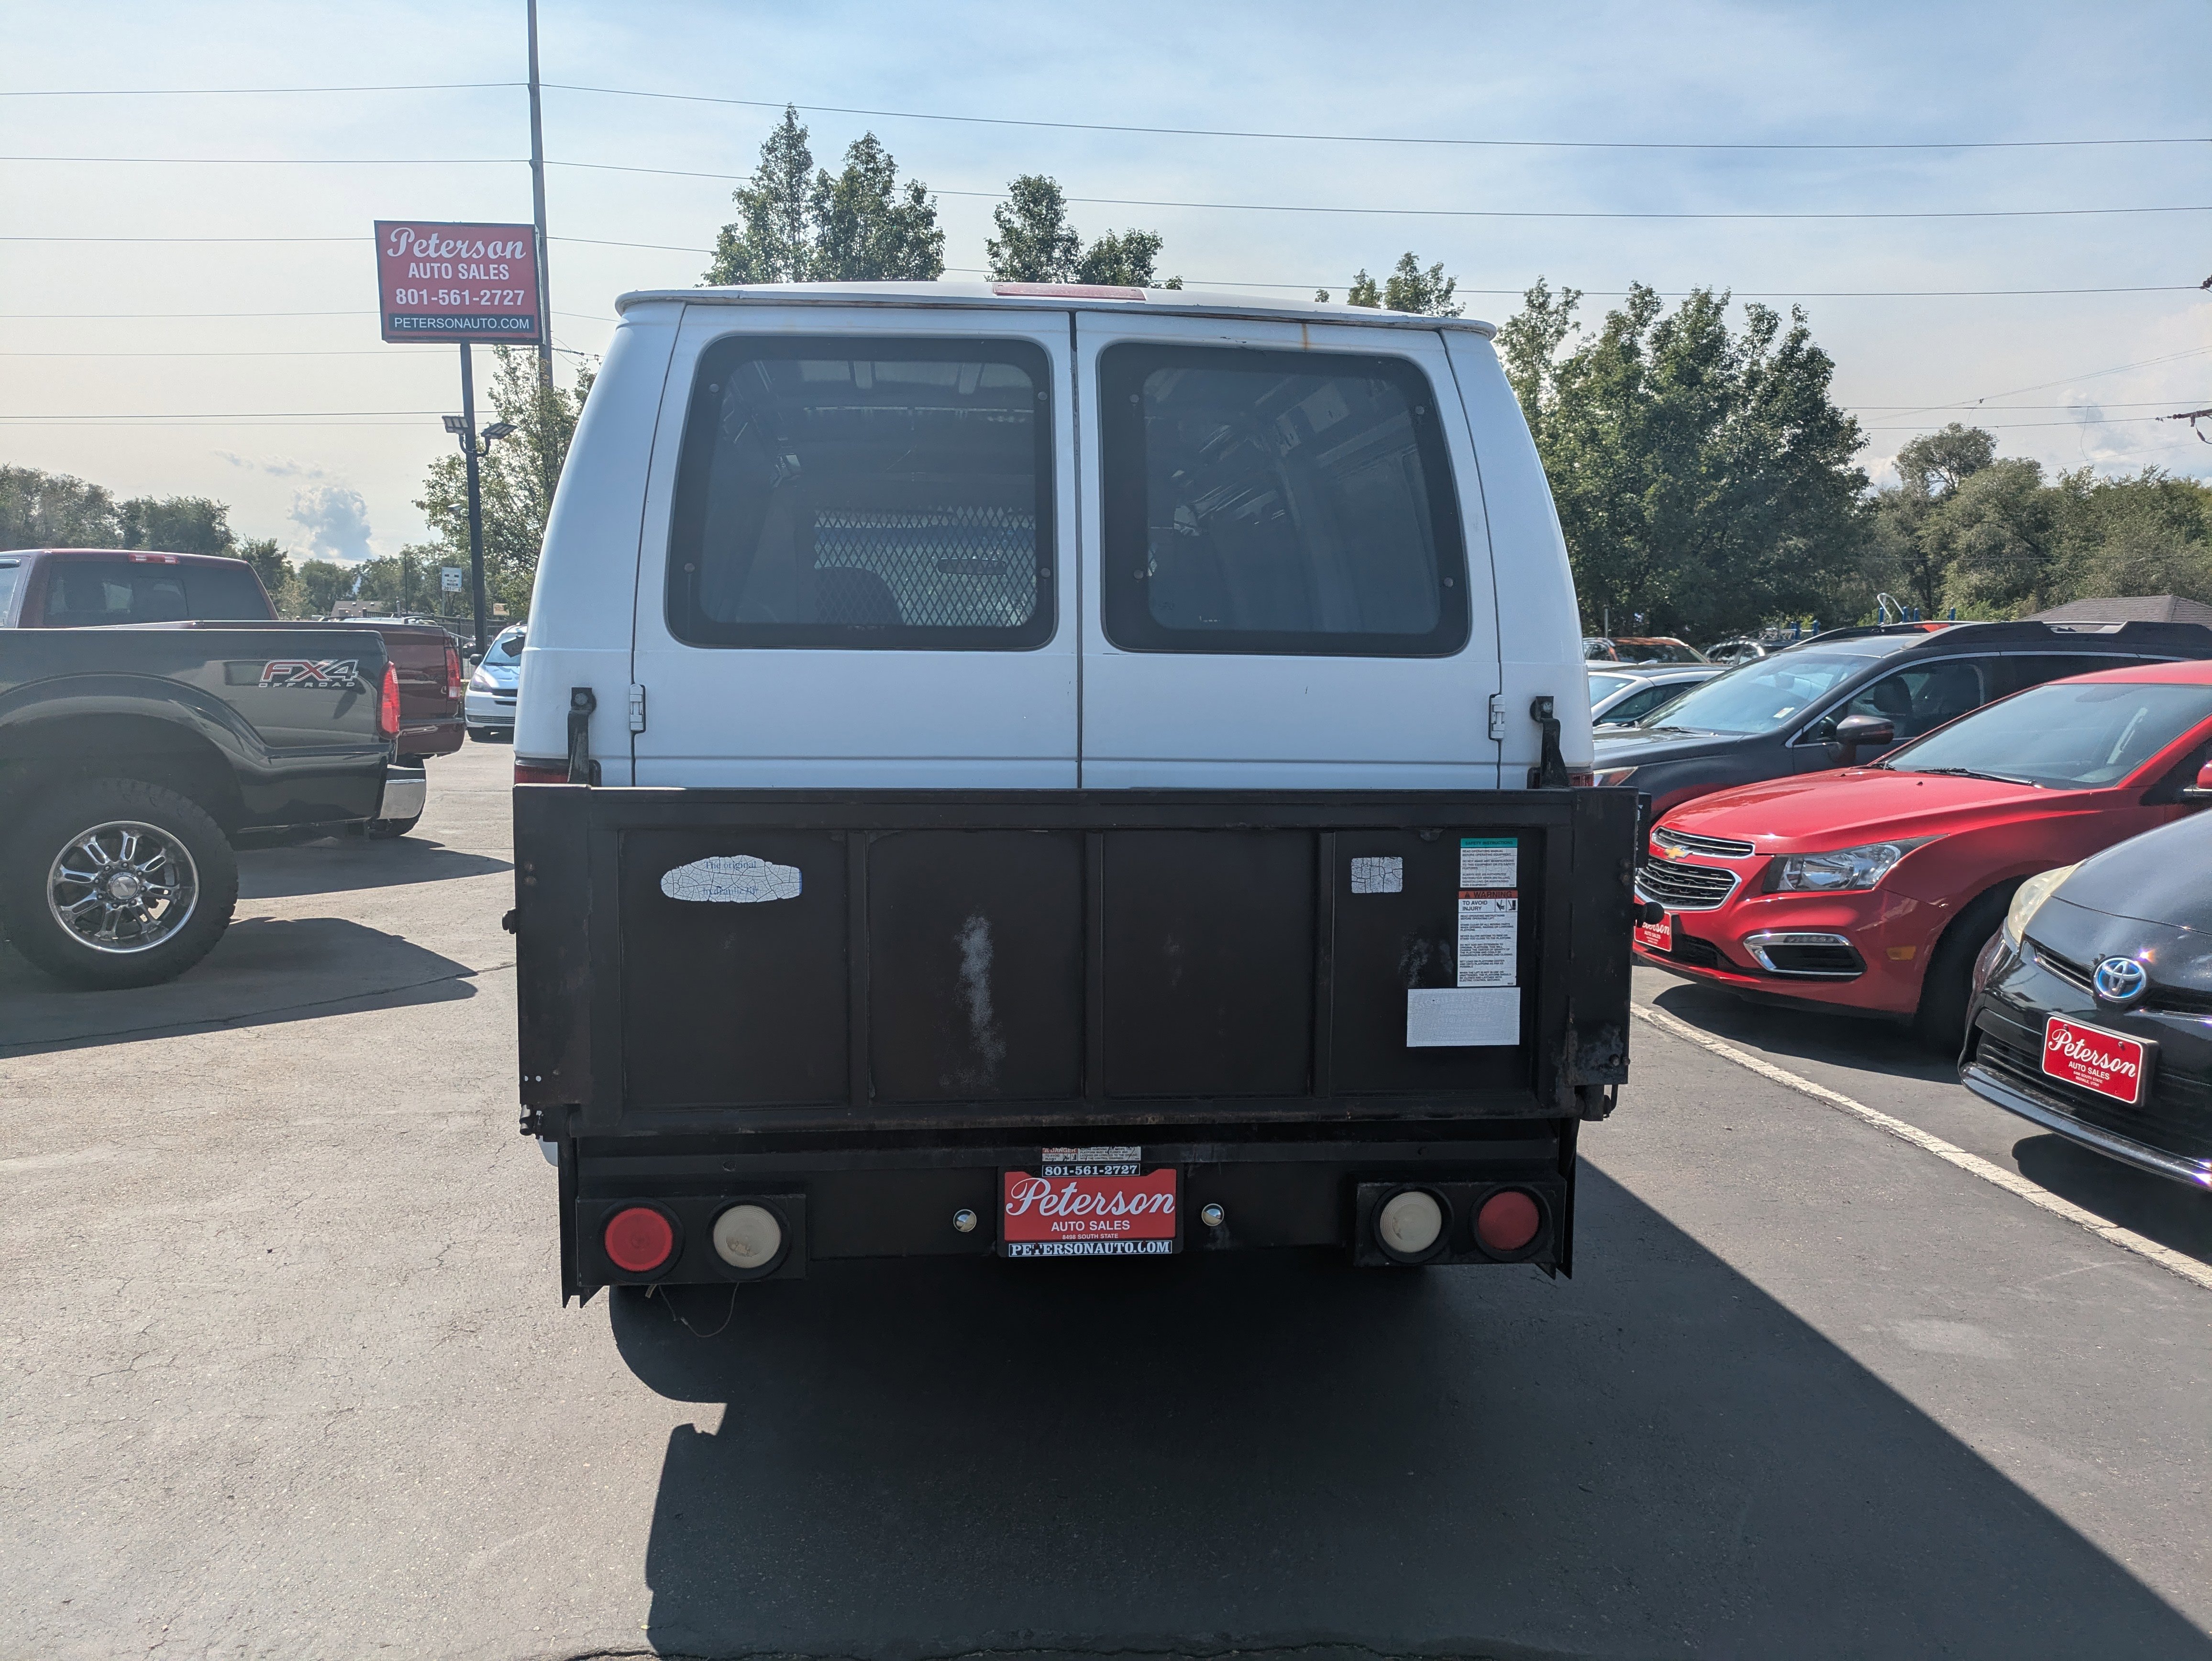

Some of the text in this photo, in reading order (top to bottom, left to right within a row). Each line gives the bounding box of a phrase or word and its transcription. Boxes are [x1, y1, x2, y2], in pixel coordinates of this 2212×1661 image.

[387, 227, 526, 259] Peterson
[409, 263, 509, 280] AUTO SALES
[396, 288, 524, 305] 801-561-2727
[395, 318, 529, 329] PETERSONAUTO.COM
[259, 659, 359, 682] FX4
[724, 861, 756, 871] original
[2048, 1029, 2136, 1077] Peterson
[2068, 1061, 2110, 1080] AUTO SALES
[1045, 1165, 1138, 1175] 801-561-2727
[1006, 1177, 1174, 1216] Peterson
[1051, 1220, 1130, 1231] AUTO SALES
[1012, 1241, 1170, 1255] PETERSONAUTO.COM
